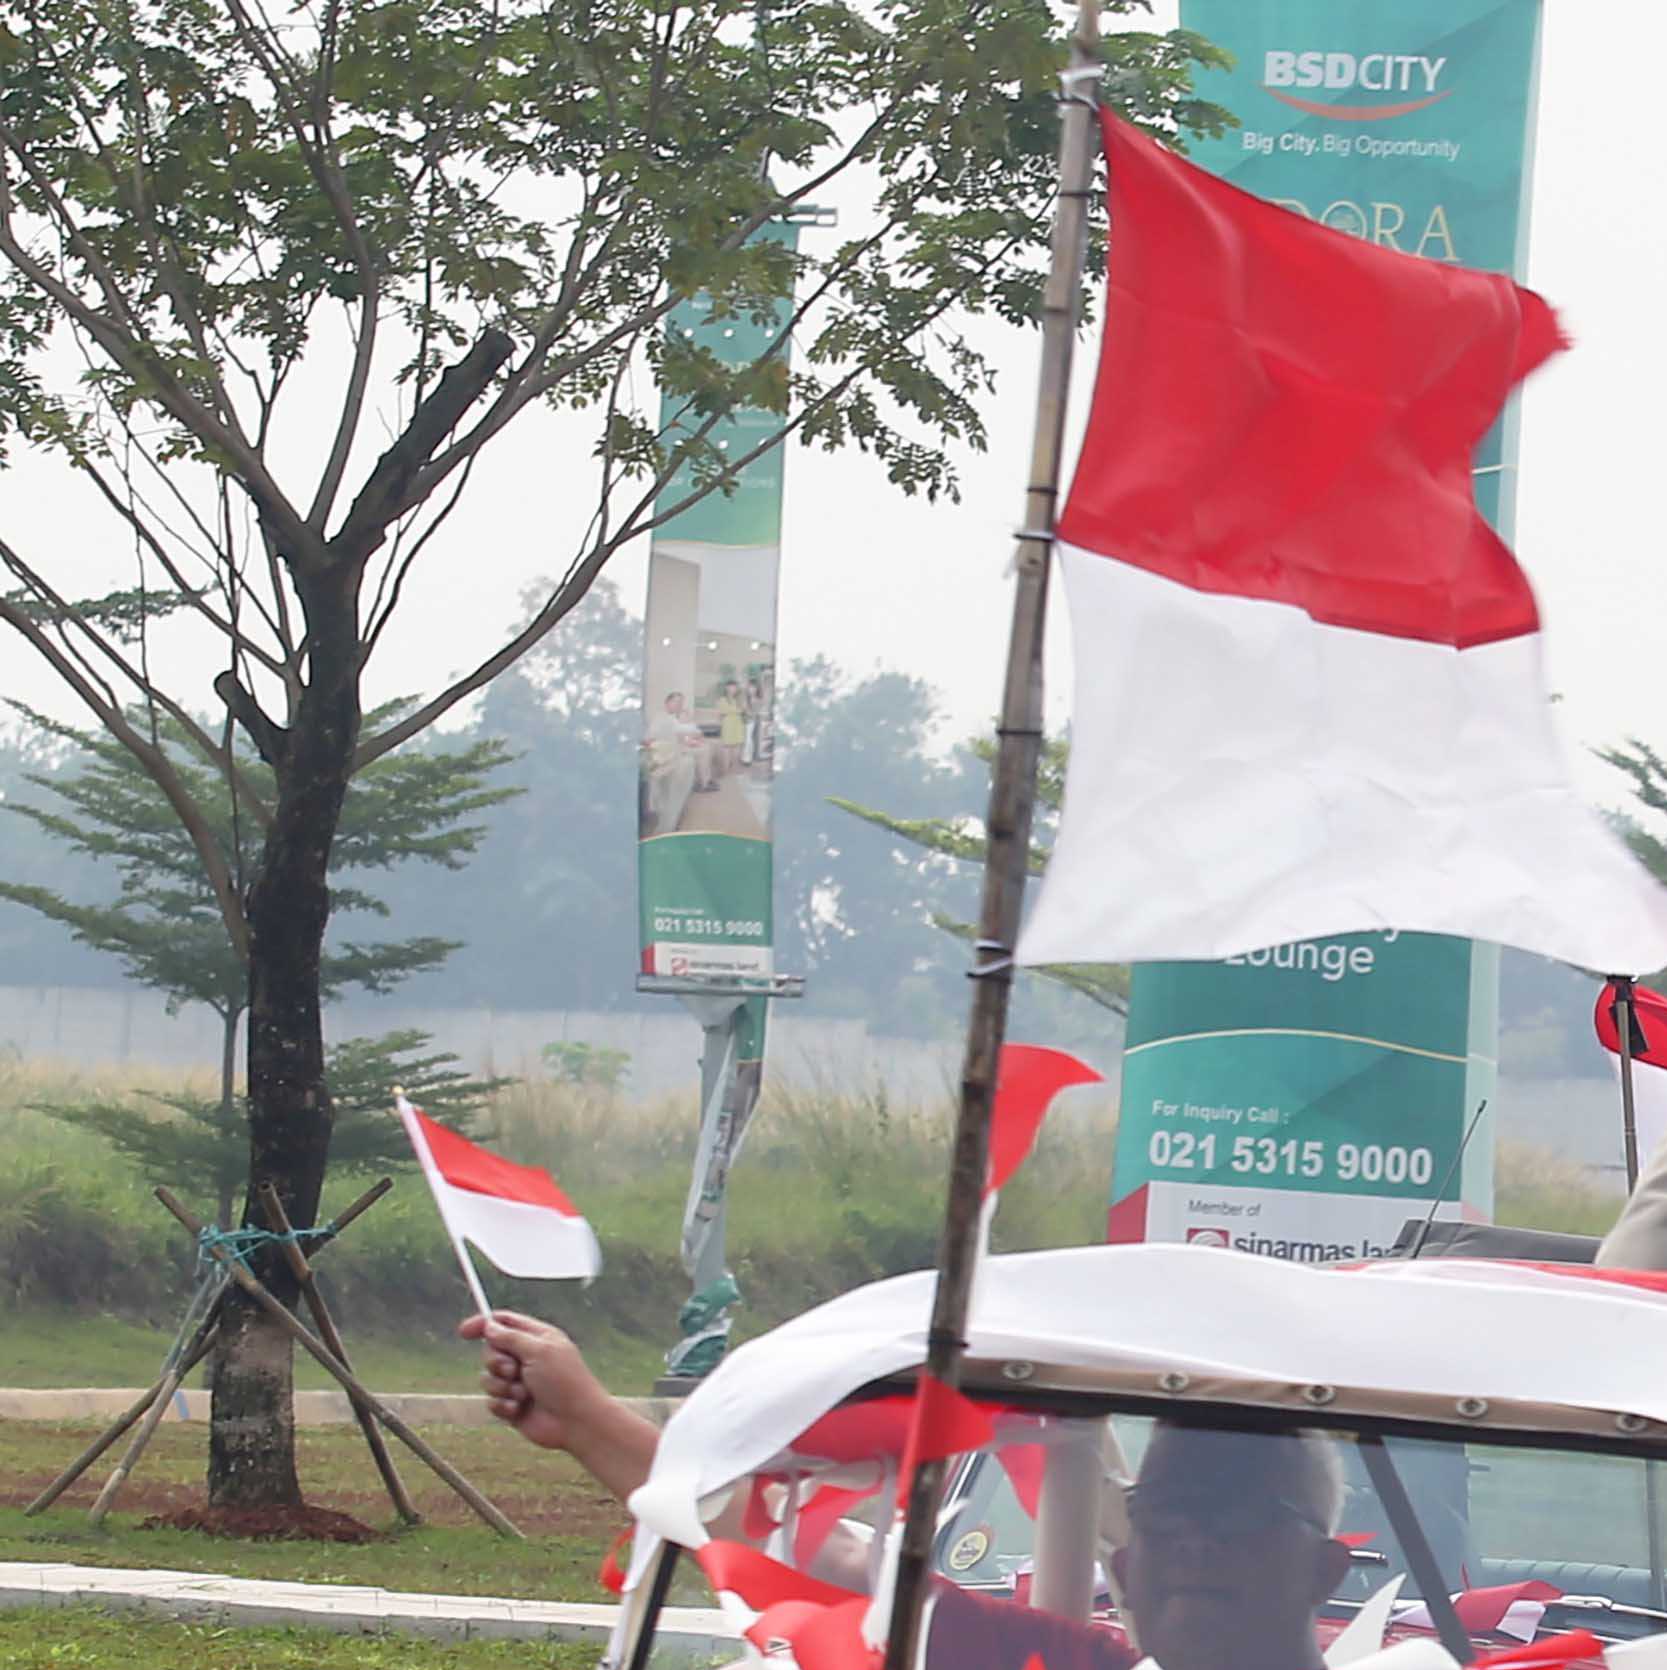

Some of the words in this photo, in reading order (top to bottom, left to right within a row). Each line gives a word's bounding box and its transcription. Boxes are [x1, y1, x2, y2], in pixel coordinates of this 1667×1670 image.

[1264, 51, 1446, 92] BSDCITY
[1243, 132, 1274, 154] Big
[1280, 133, 1319, 156] City.
[1323, 134, 1350, 157] Big
[1356, 135, 1461, 161] Opportunity
[1152, 1099, 1177, 1117] For
[1184, 1103, 1242, 1125] Inquiry
[1248, 1106, 1278, 1124] Call
[1149, 1131, 1216, 1169] 021
[1231, 1136, 1324, 1177] 5315
[1337, 1144, 1432, 1185] 9000
[1188, 1200, 1243, 1217] Member
[1247, 1200, 1261, 1217] of
